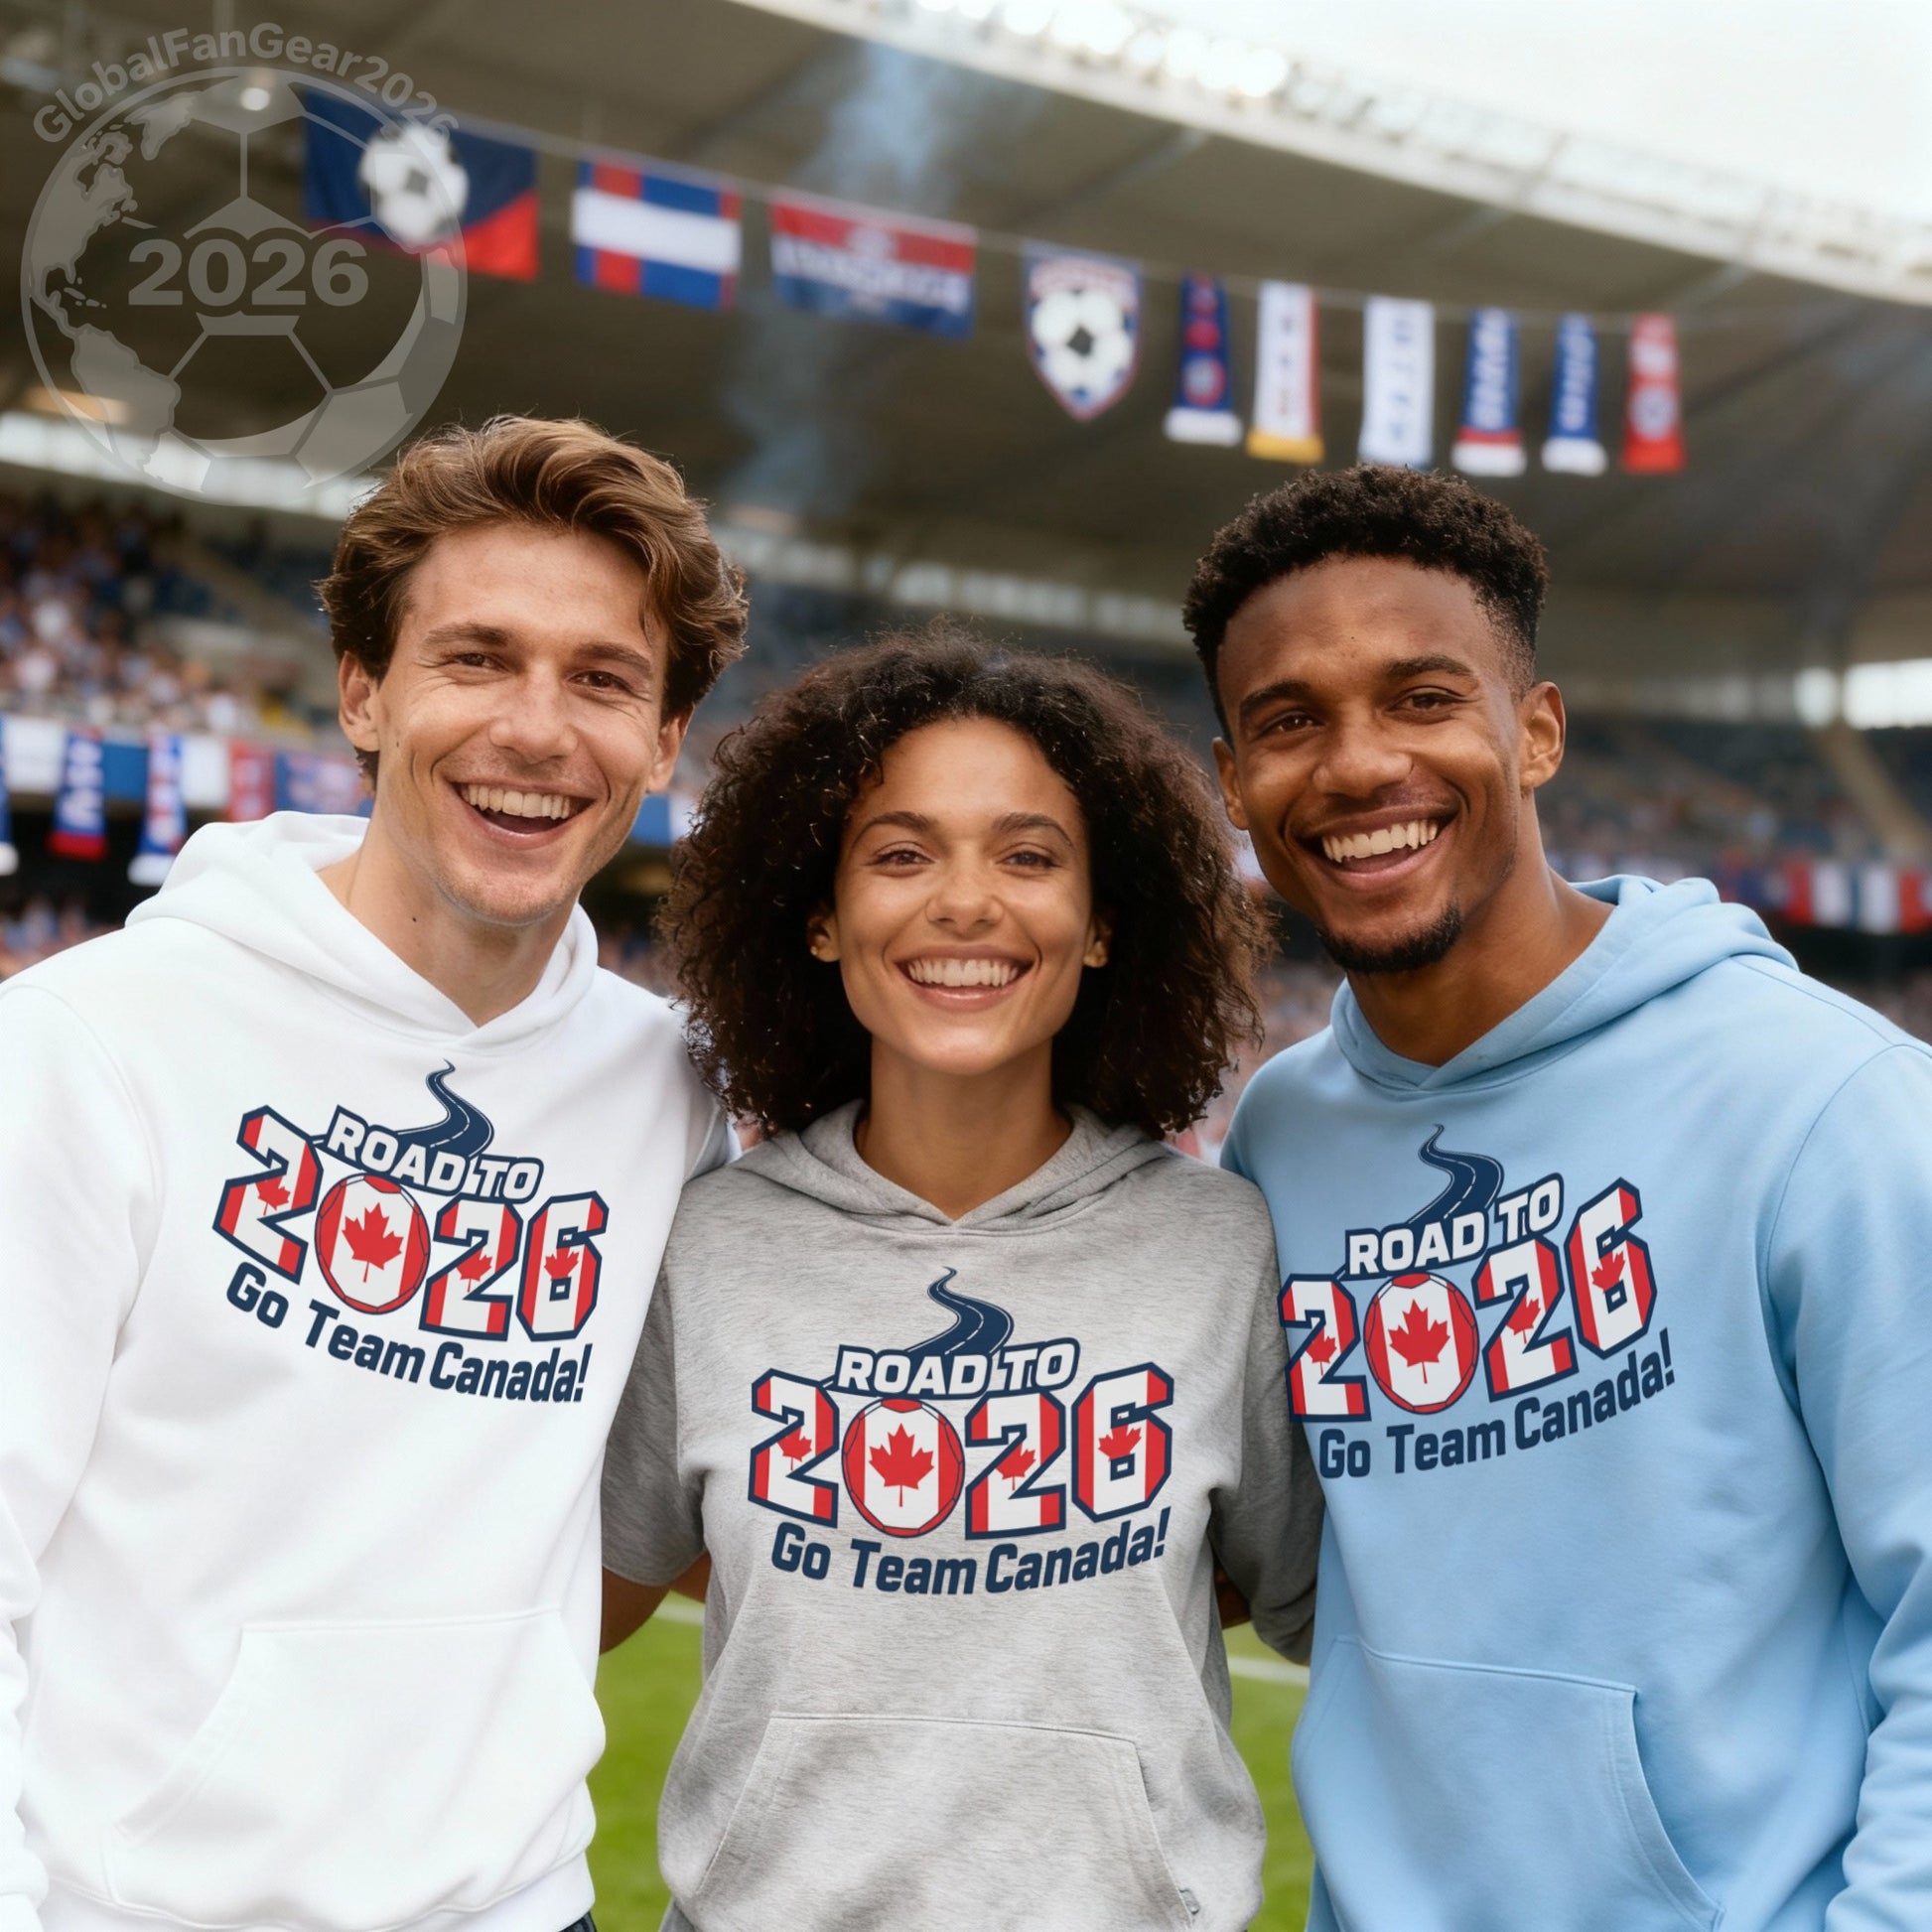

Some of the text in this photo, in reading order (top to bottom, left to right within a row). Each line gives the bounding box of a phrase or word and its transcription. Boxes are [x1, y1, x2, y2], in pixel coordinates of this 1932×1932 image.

[212, 1104, 610, 1342] 2026
[326, 1104, 544, 1203] ROAD TO
[1345, 1173, 1565, 1281] ROAD TO
[225, 1261, 594, 1403] Go Team Canada!
[836, 1337, 1081, 1401] ROAD TO
[1277, 1176, 1657, 1423] 2026
[747, 1361, 1174, 1541] 2026
[1318, 1326, 1676, 1479] Go Team Canada!
[770, 1506, 1172, 1595] Go Team Canada!
